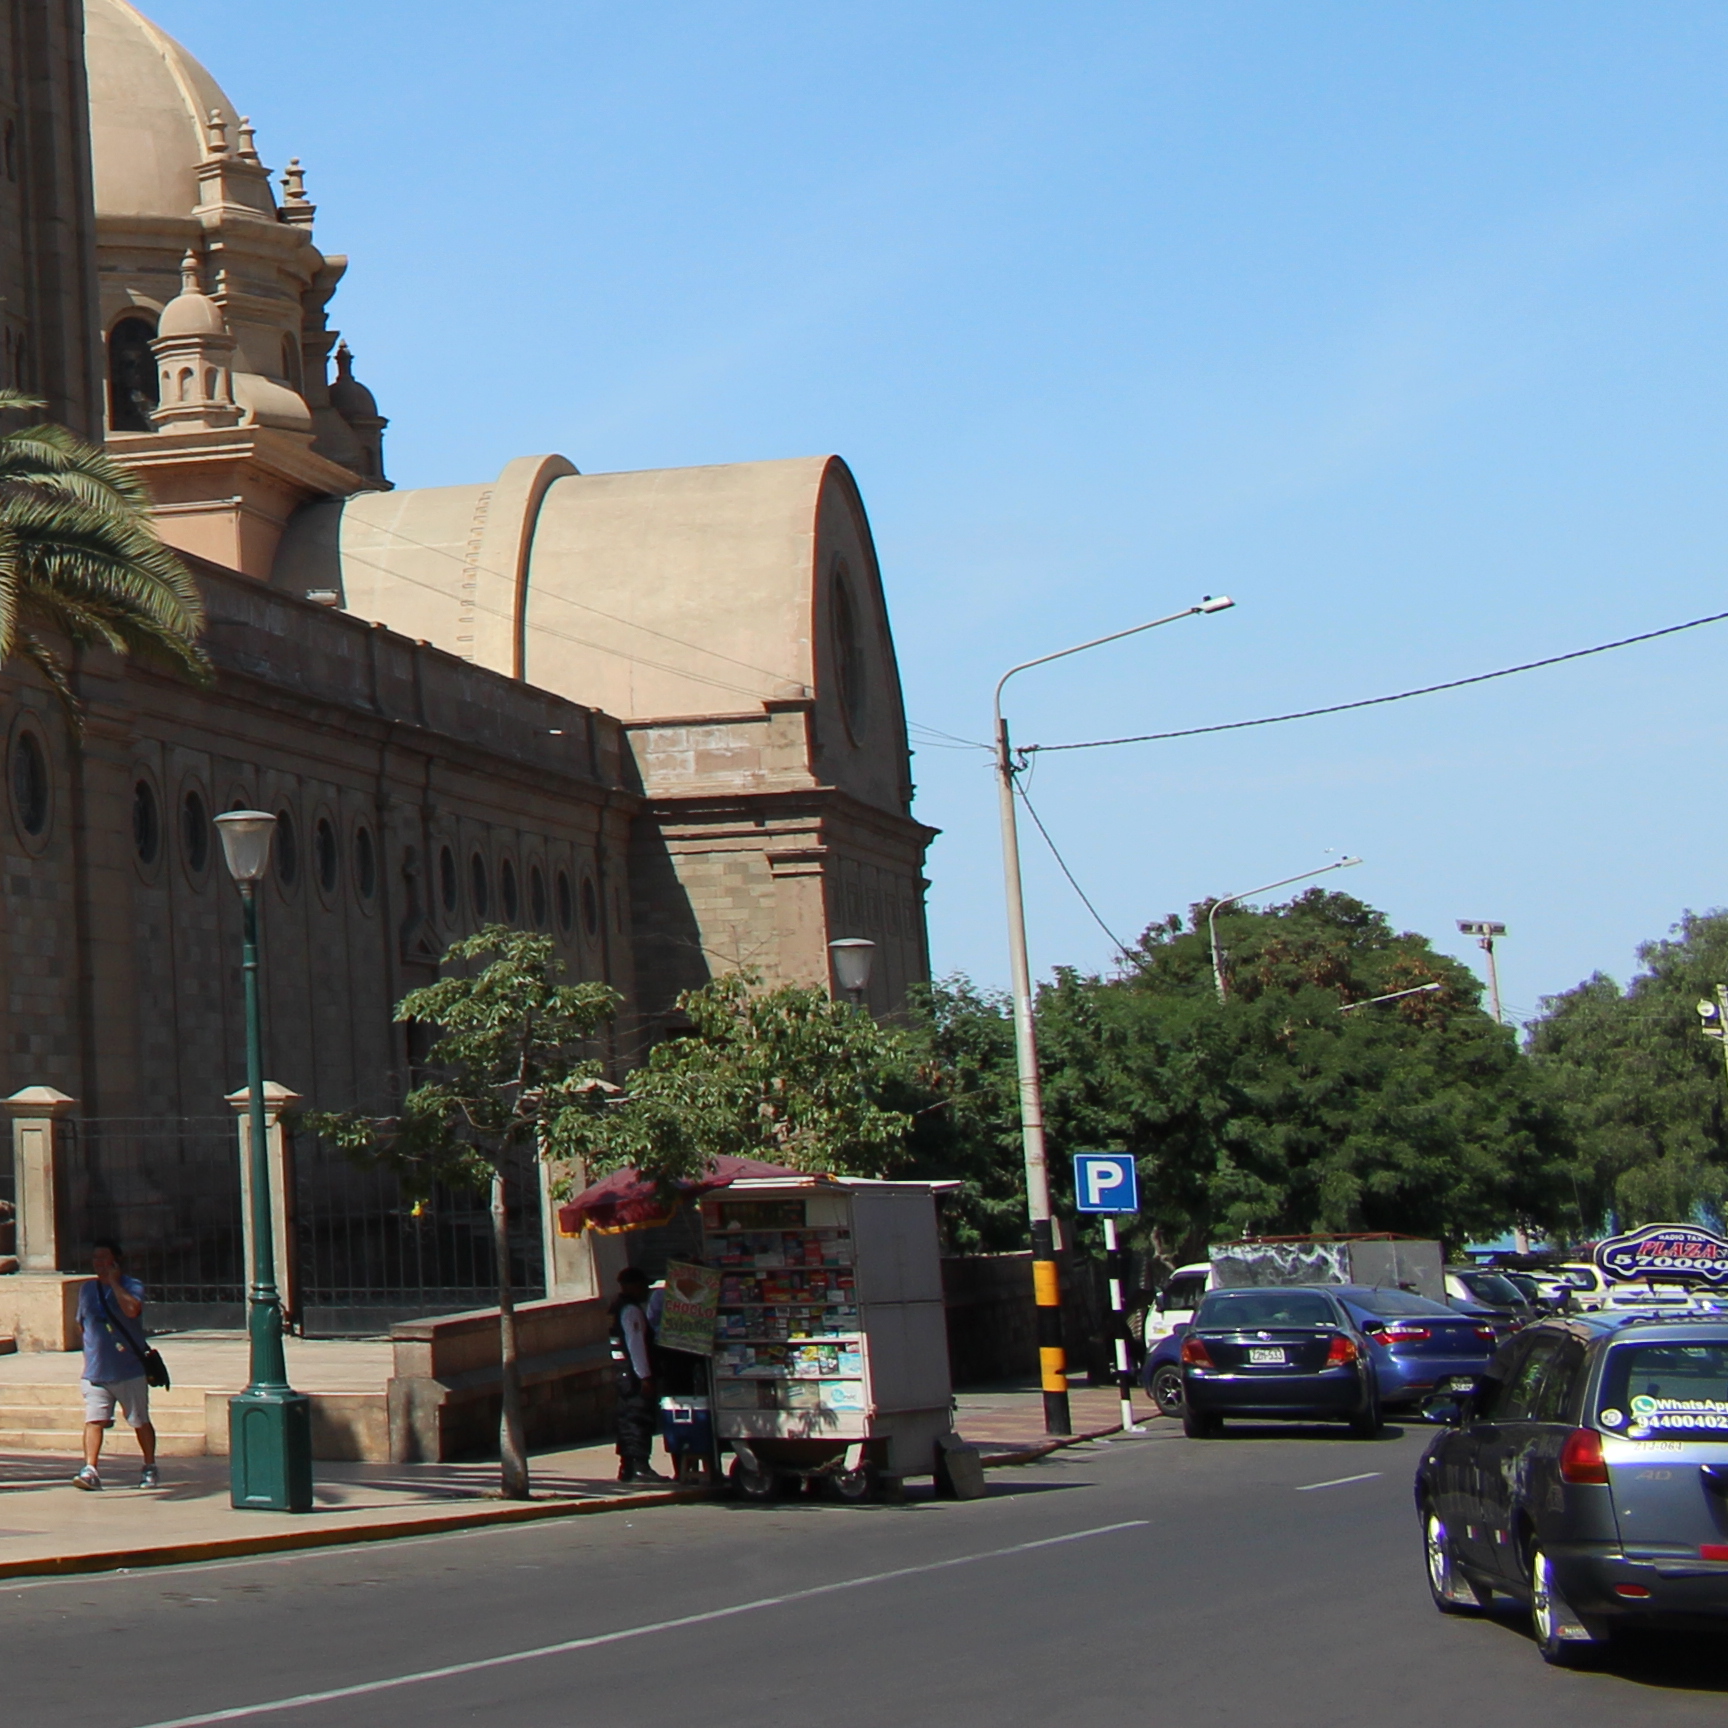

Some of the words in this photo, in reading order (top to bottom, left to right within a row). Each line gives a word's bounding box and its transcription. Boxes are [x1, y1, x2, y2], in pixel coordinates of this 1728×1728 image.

[1086, 1160, 1124, 1205] P
[1637, 1241, 1717, 1259] PLAZA
[1613, 1254, 1728, 1271] 570000
[665, 1300, 716, 1320] CHOCLO
[1634, 1470, 1673, 1480] AD
